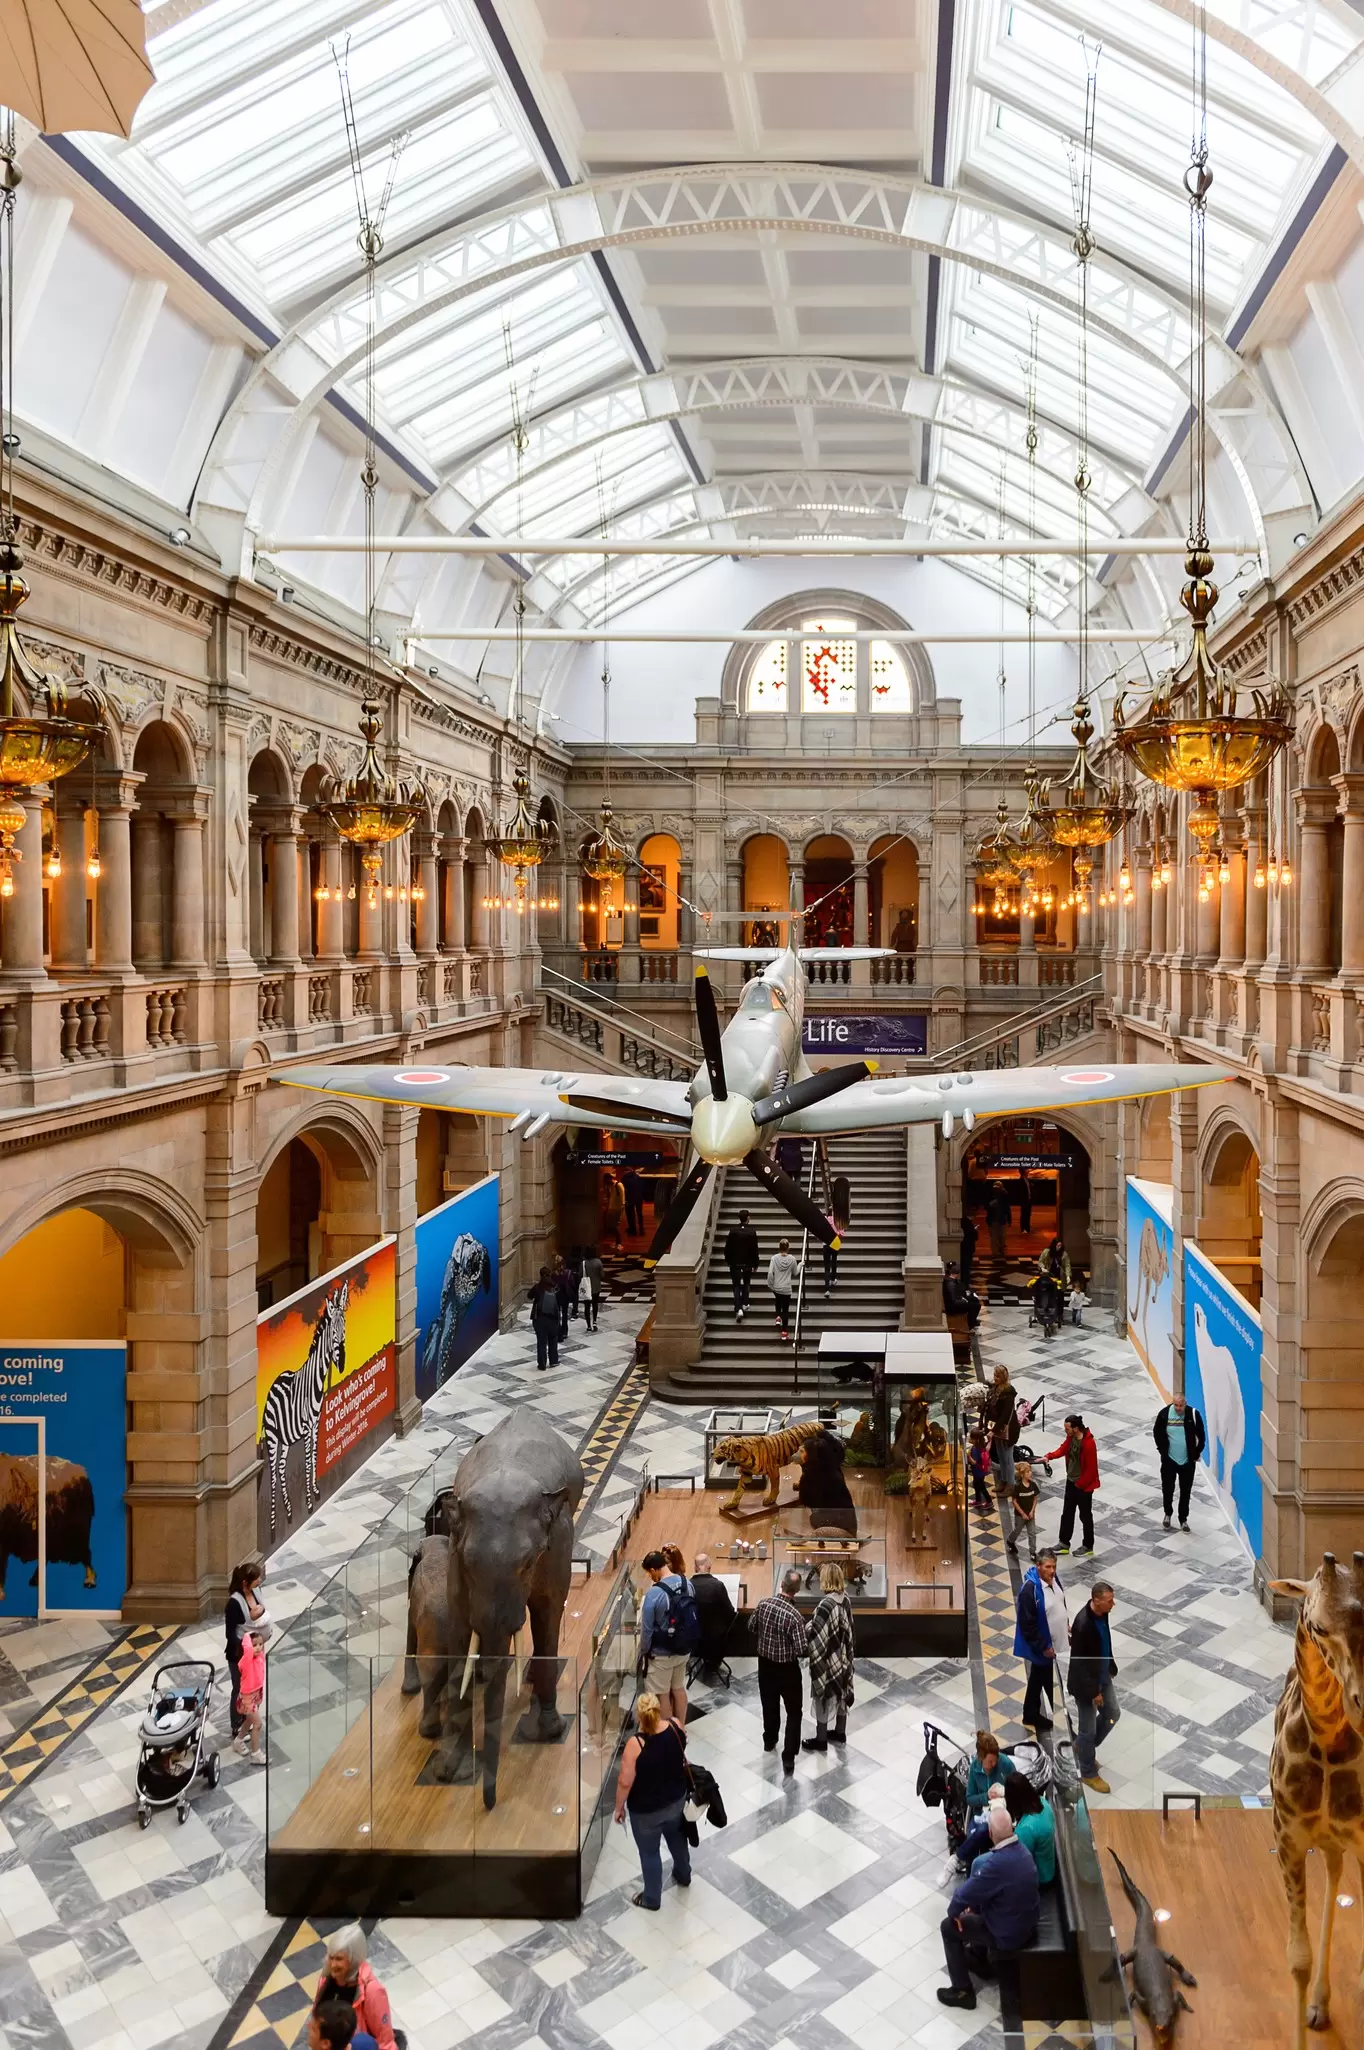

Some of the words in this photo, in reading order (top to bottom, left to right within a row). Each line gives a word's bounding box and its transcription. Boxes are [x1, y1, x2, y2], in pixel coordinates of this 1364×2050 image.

[807, 1019, 849, 1042] Life
[3, 1354, 64, 1373] coming
[0, 1371, 33, 1385] ove!
[325, 1389, 343, 1415] Look
[343, 1373, 363, 1399] who's
[363, 1356, 386, 1381] coming
[0, 1394, 7, 1402] e
[10, 1391, 68, 1404] completed
[325, 1417, 334, 1432] to
[335, 1378, 376, 1422] Kelvingrove!
[0, 1405, 15, 1416] 16.
[325, 1434, 336, 1449] This
[335, 1421, 352, 1440] display
[351, 1411, 360, 1427] will
[359, 1408, 366, 1419] be
[365, 1386, 388, 1414] completed
[325, 1444, 342, 1464] during
[341, 1430, 357, 1449] Winter
